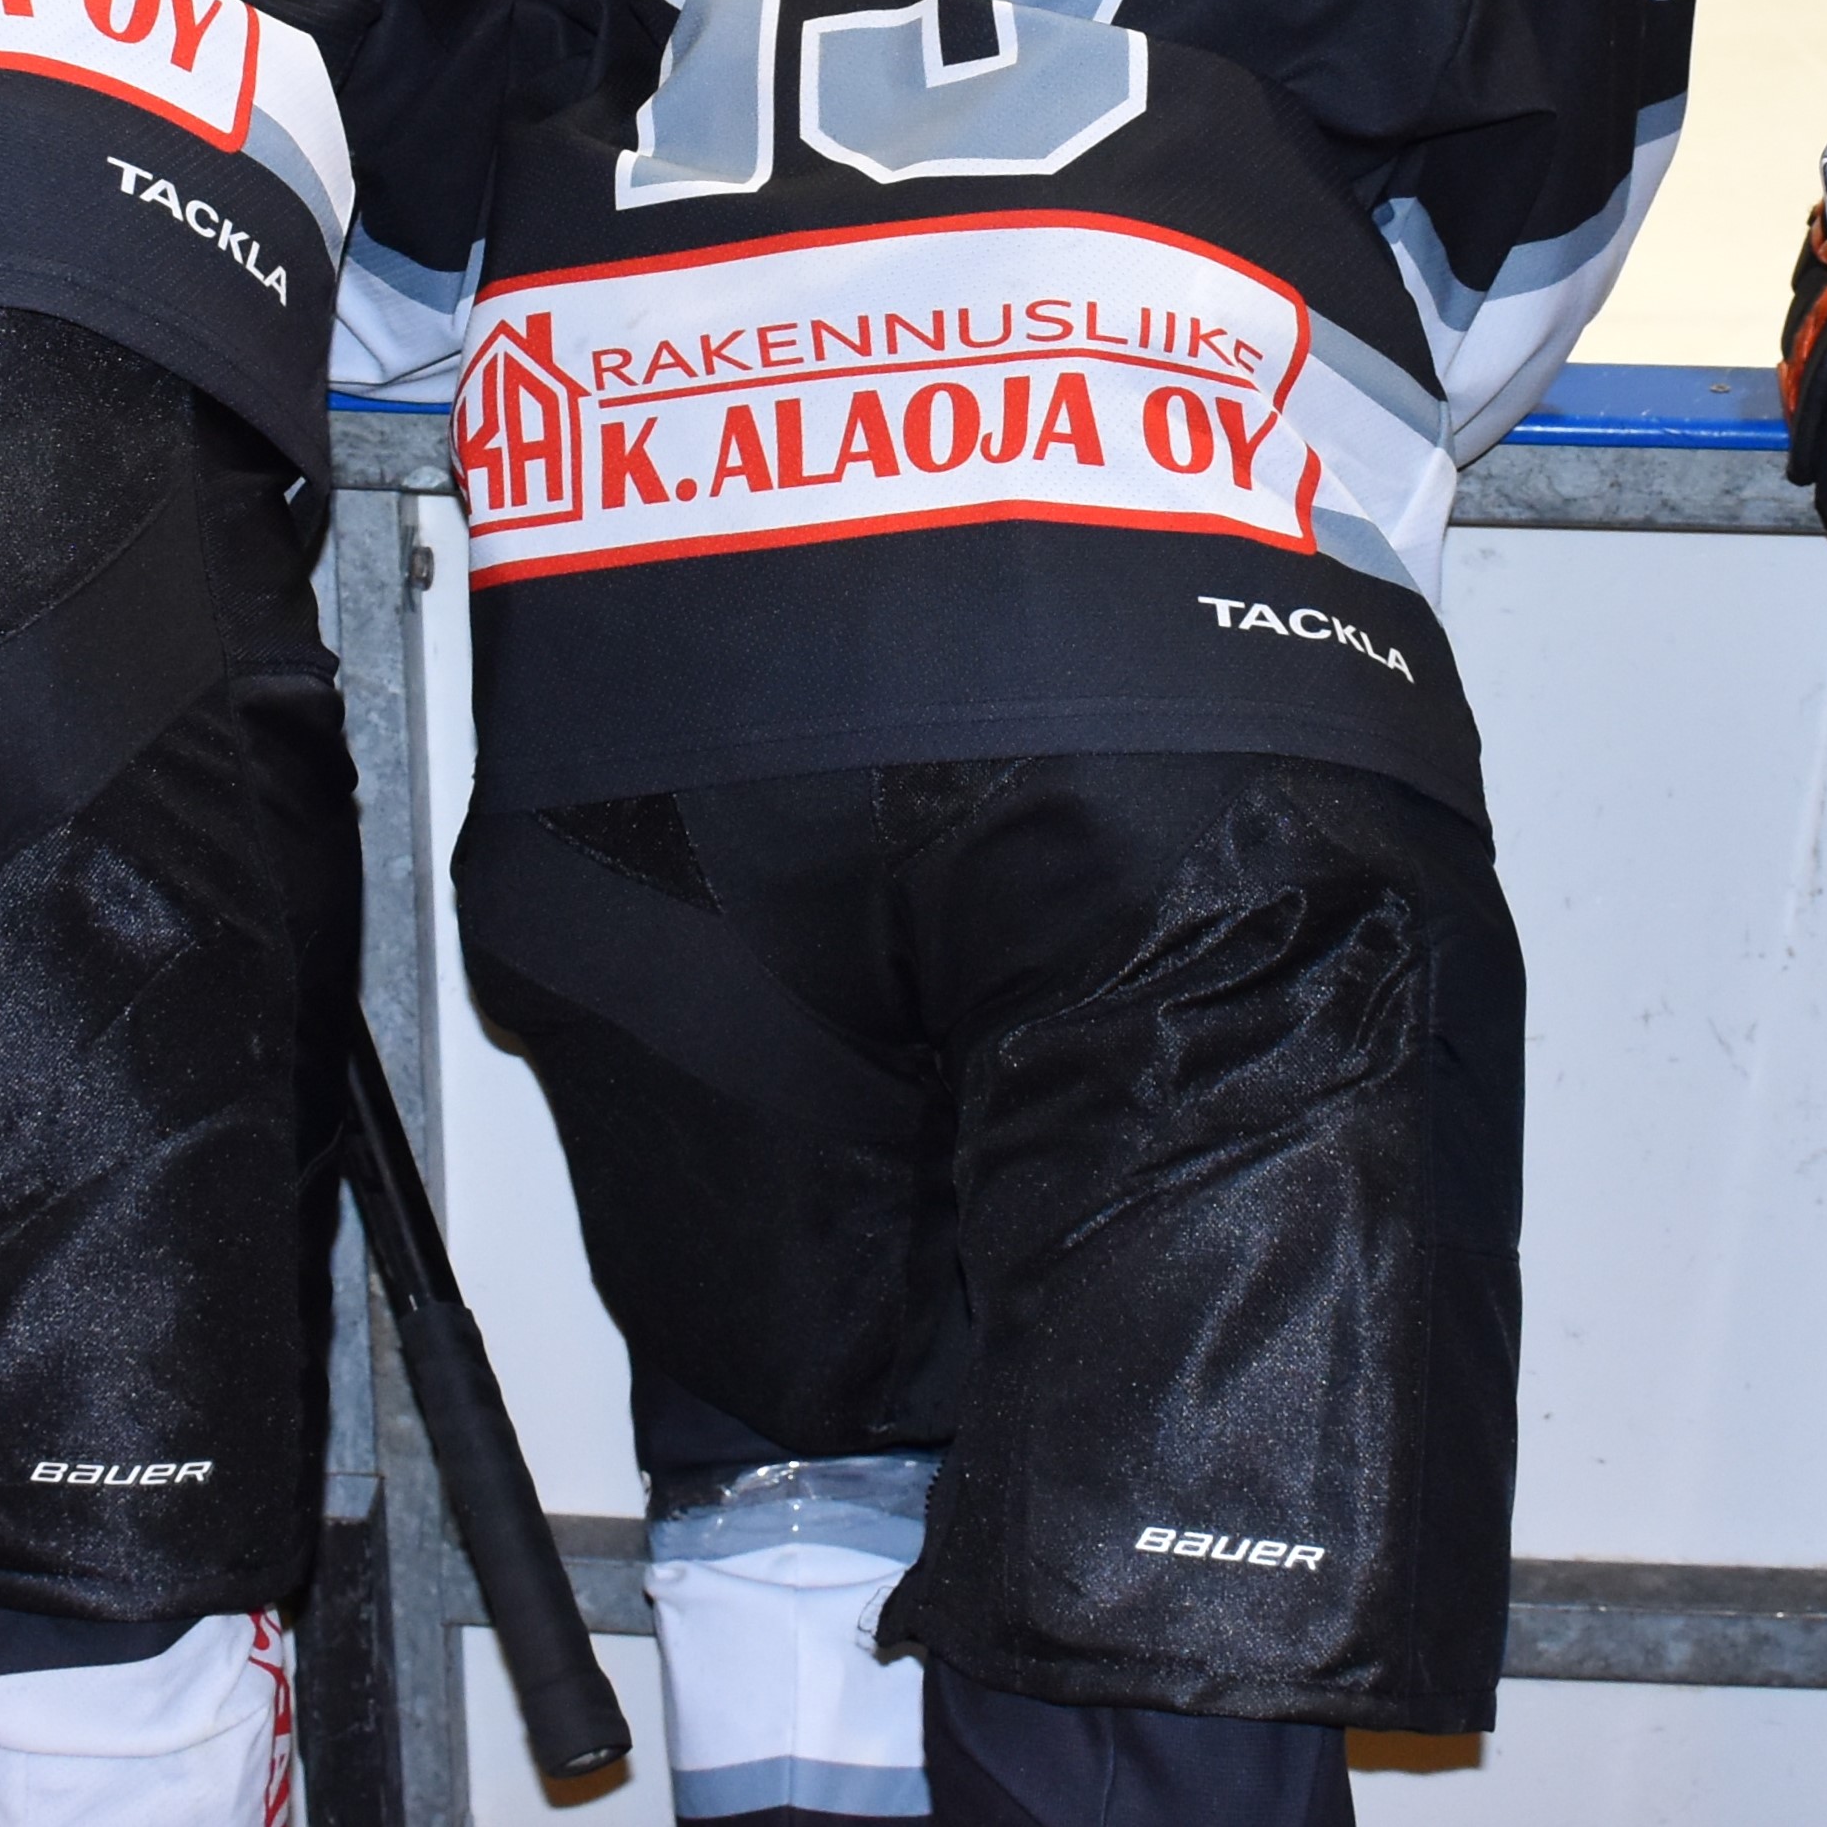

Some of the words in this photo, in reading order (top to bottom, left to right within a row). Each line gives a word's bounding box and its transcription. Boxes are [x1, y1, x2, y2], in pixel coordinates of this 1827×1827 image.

[104, 155, 290, 307] TACKLA
[591, 298, 1264, 393] RAKENNUSLIIKE
[598, 372, 1106, 512] K.ALAOJA
[1142, 384, 1284, 493] OY
[1197, 594, 1415, 684] TACKLA
[28, 1459, 213, 1488] BAUER
[1133, 1523, 1327, 1574] BAUER
